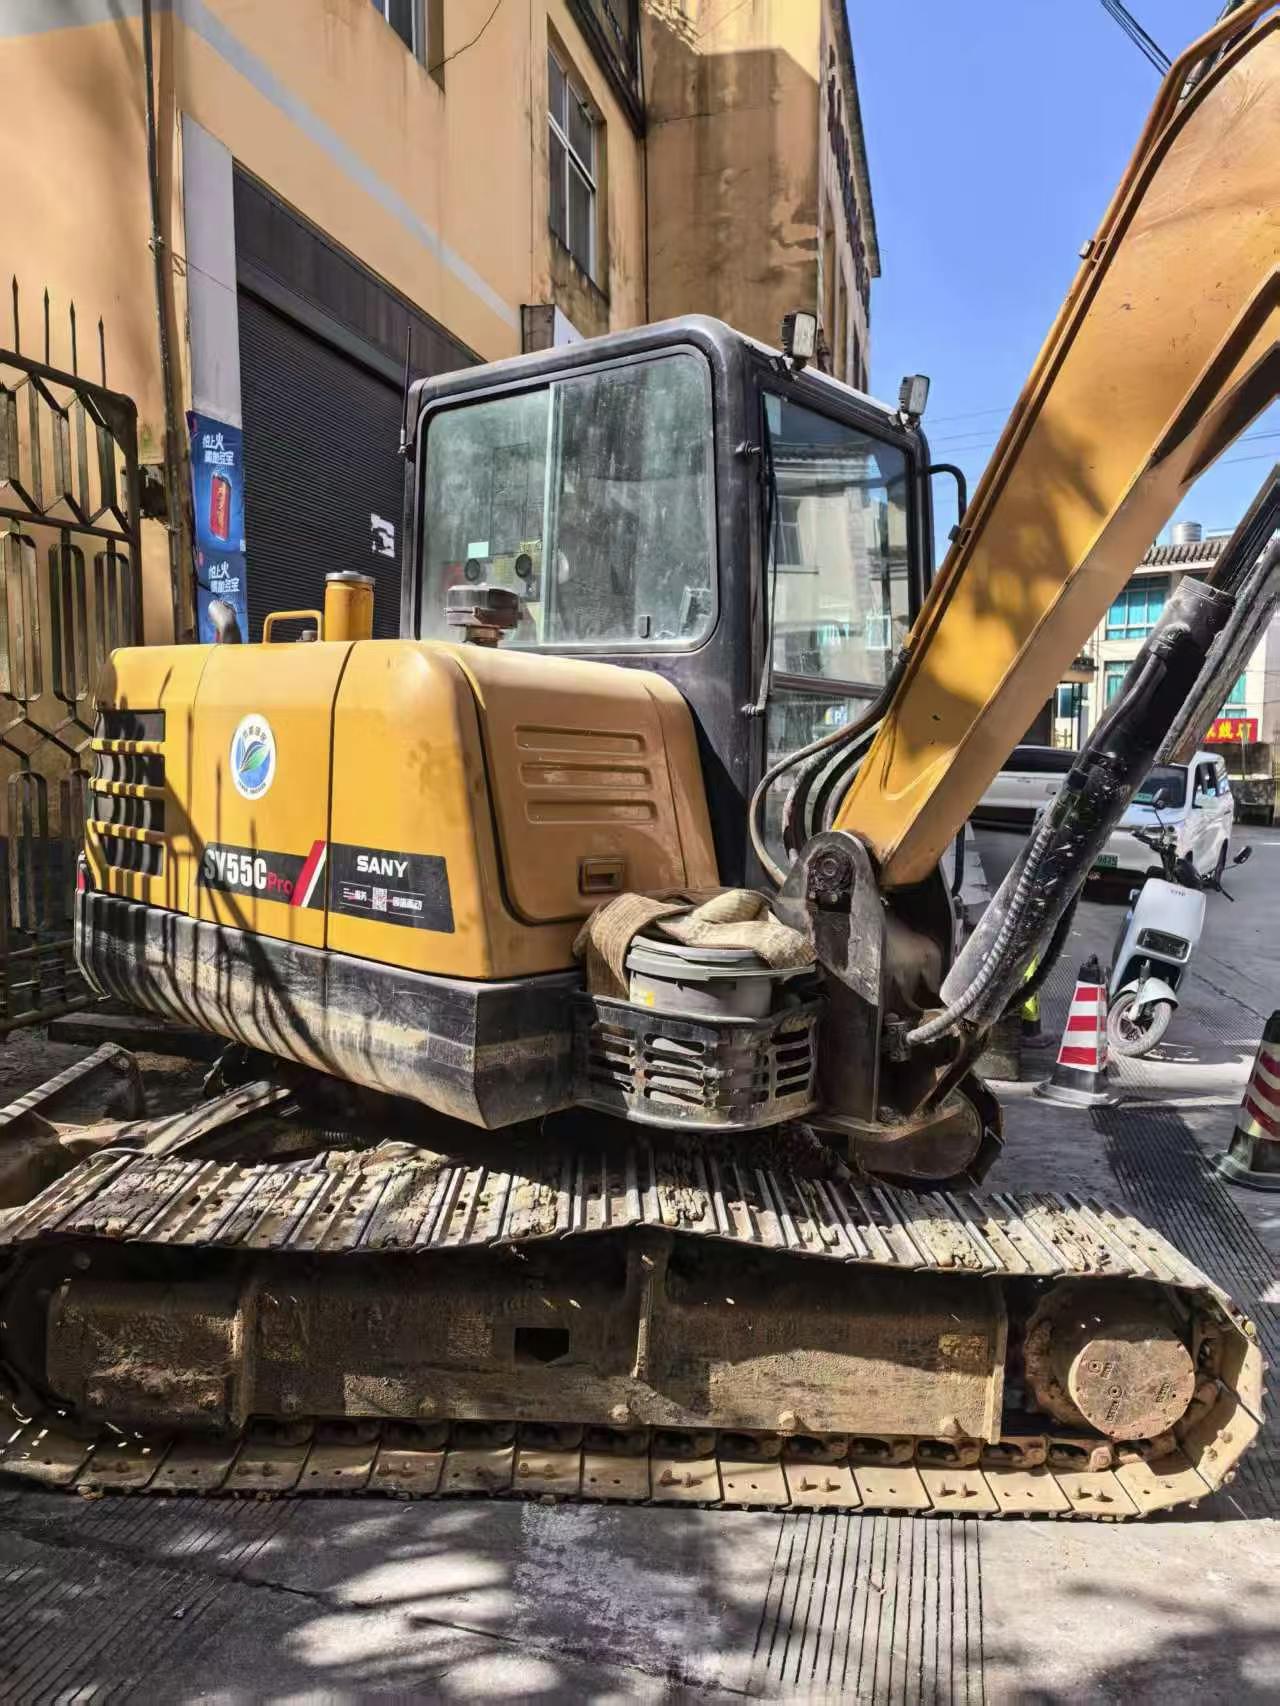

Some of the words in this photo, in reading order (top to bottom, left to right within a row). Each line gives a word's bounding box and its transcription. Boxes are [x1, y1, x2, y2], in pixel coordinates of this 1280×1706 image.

[204, 848, 268, 890] SY55C
[267, 872, 293, 896] Pro
[356, 855, 409, 878] SANY
